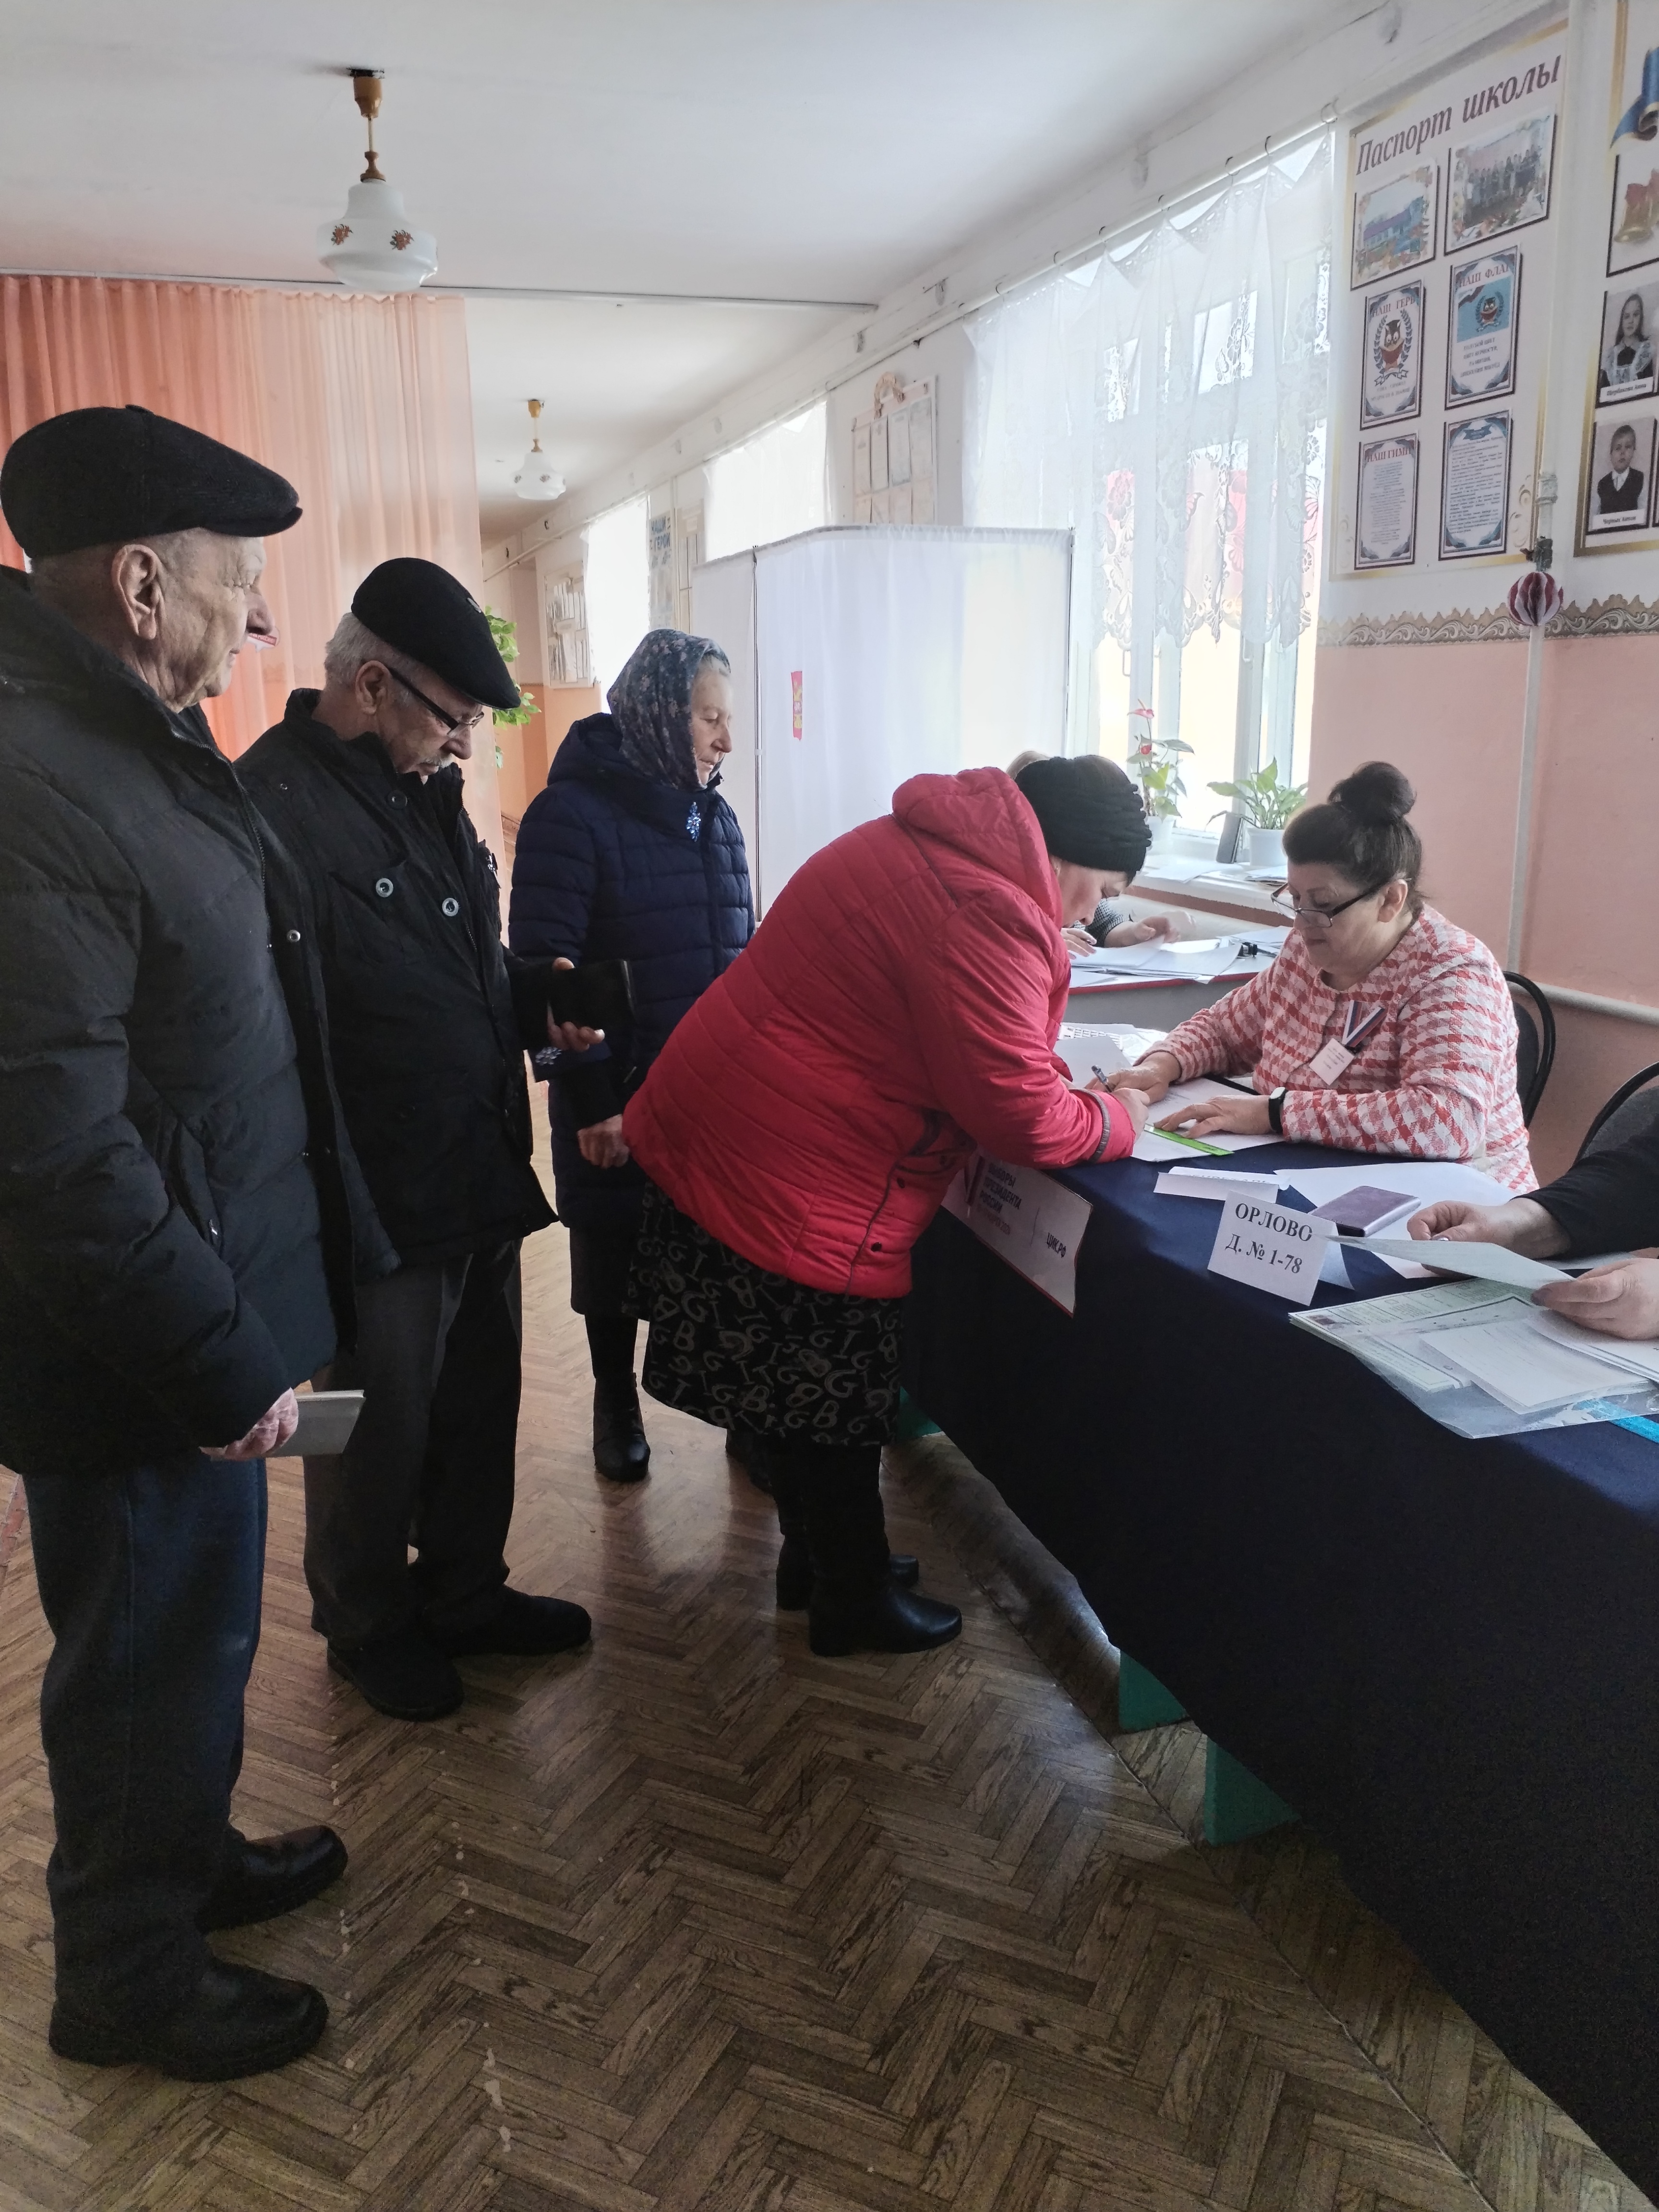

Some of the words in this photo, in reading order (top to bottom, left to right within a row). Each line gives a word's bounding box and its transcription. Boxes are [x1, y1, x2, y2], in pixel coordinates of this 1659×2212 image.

[1356, 107, 1452, 176] Паспорт
[1462, 55, 1561, 123] школы
[988, 1162, 1016, 1188] ВЫБОРЫ
[979, 1190, 1003, 1214] РОССИИ
[984, 1176, 1022, 1210] ПРЕЗИДЕНТА
[1235, 1203, 1313, 1241] ОРЛОВО
[1046, 1232, 1067, 1258] ЦИК.РФ
[1225, 1233, 1242, 1254] Д.
[1246, 1240, 1265, 1260] №
[1269, 1250, 1302, 1274] 1-78
